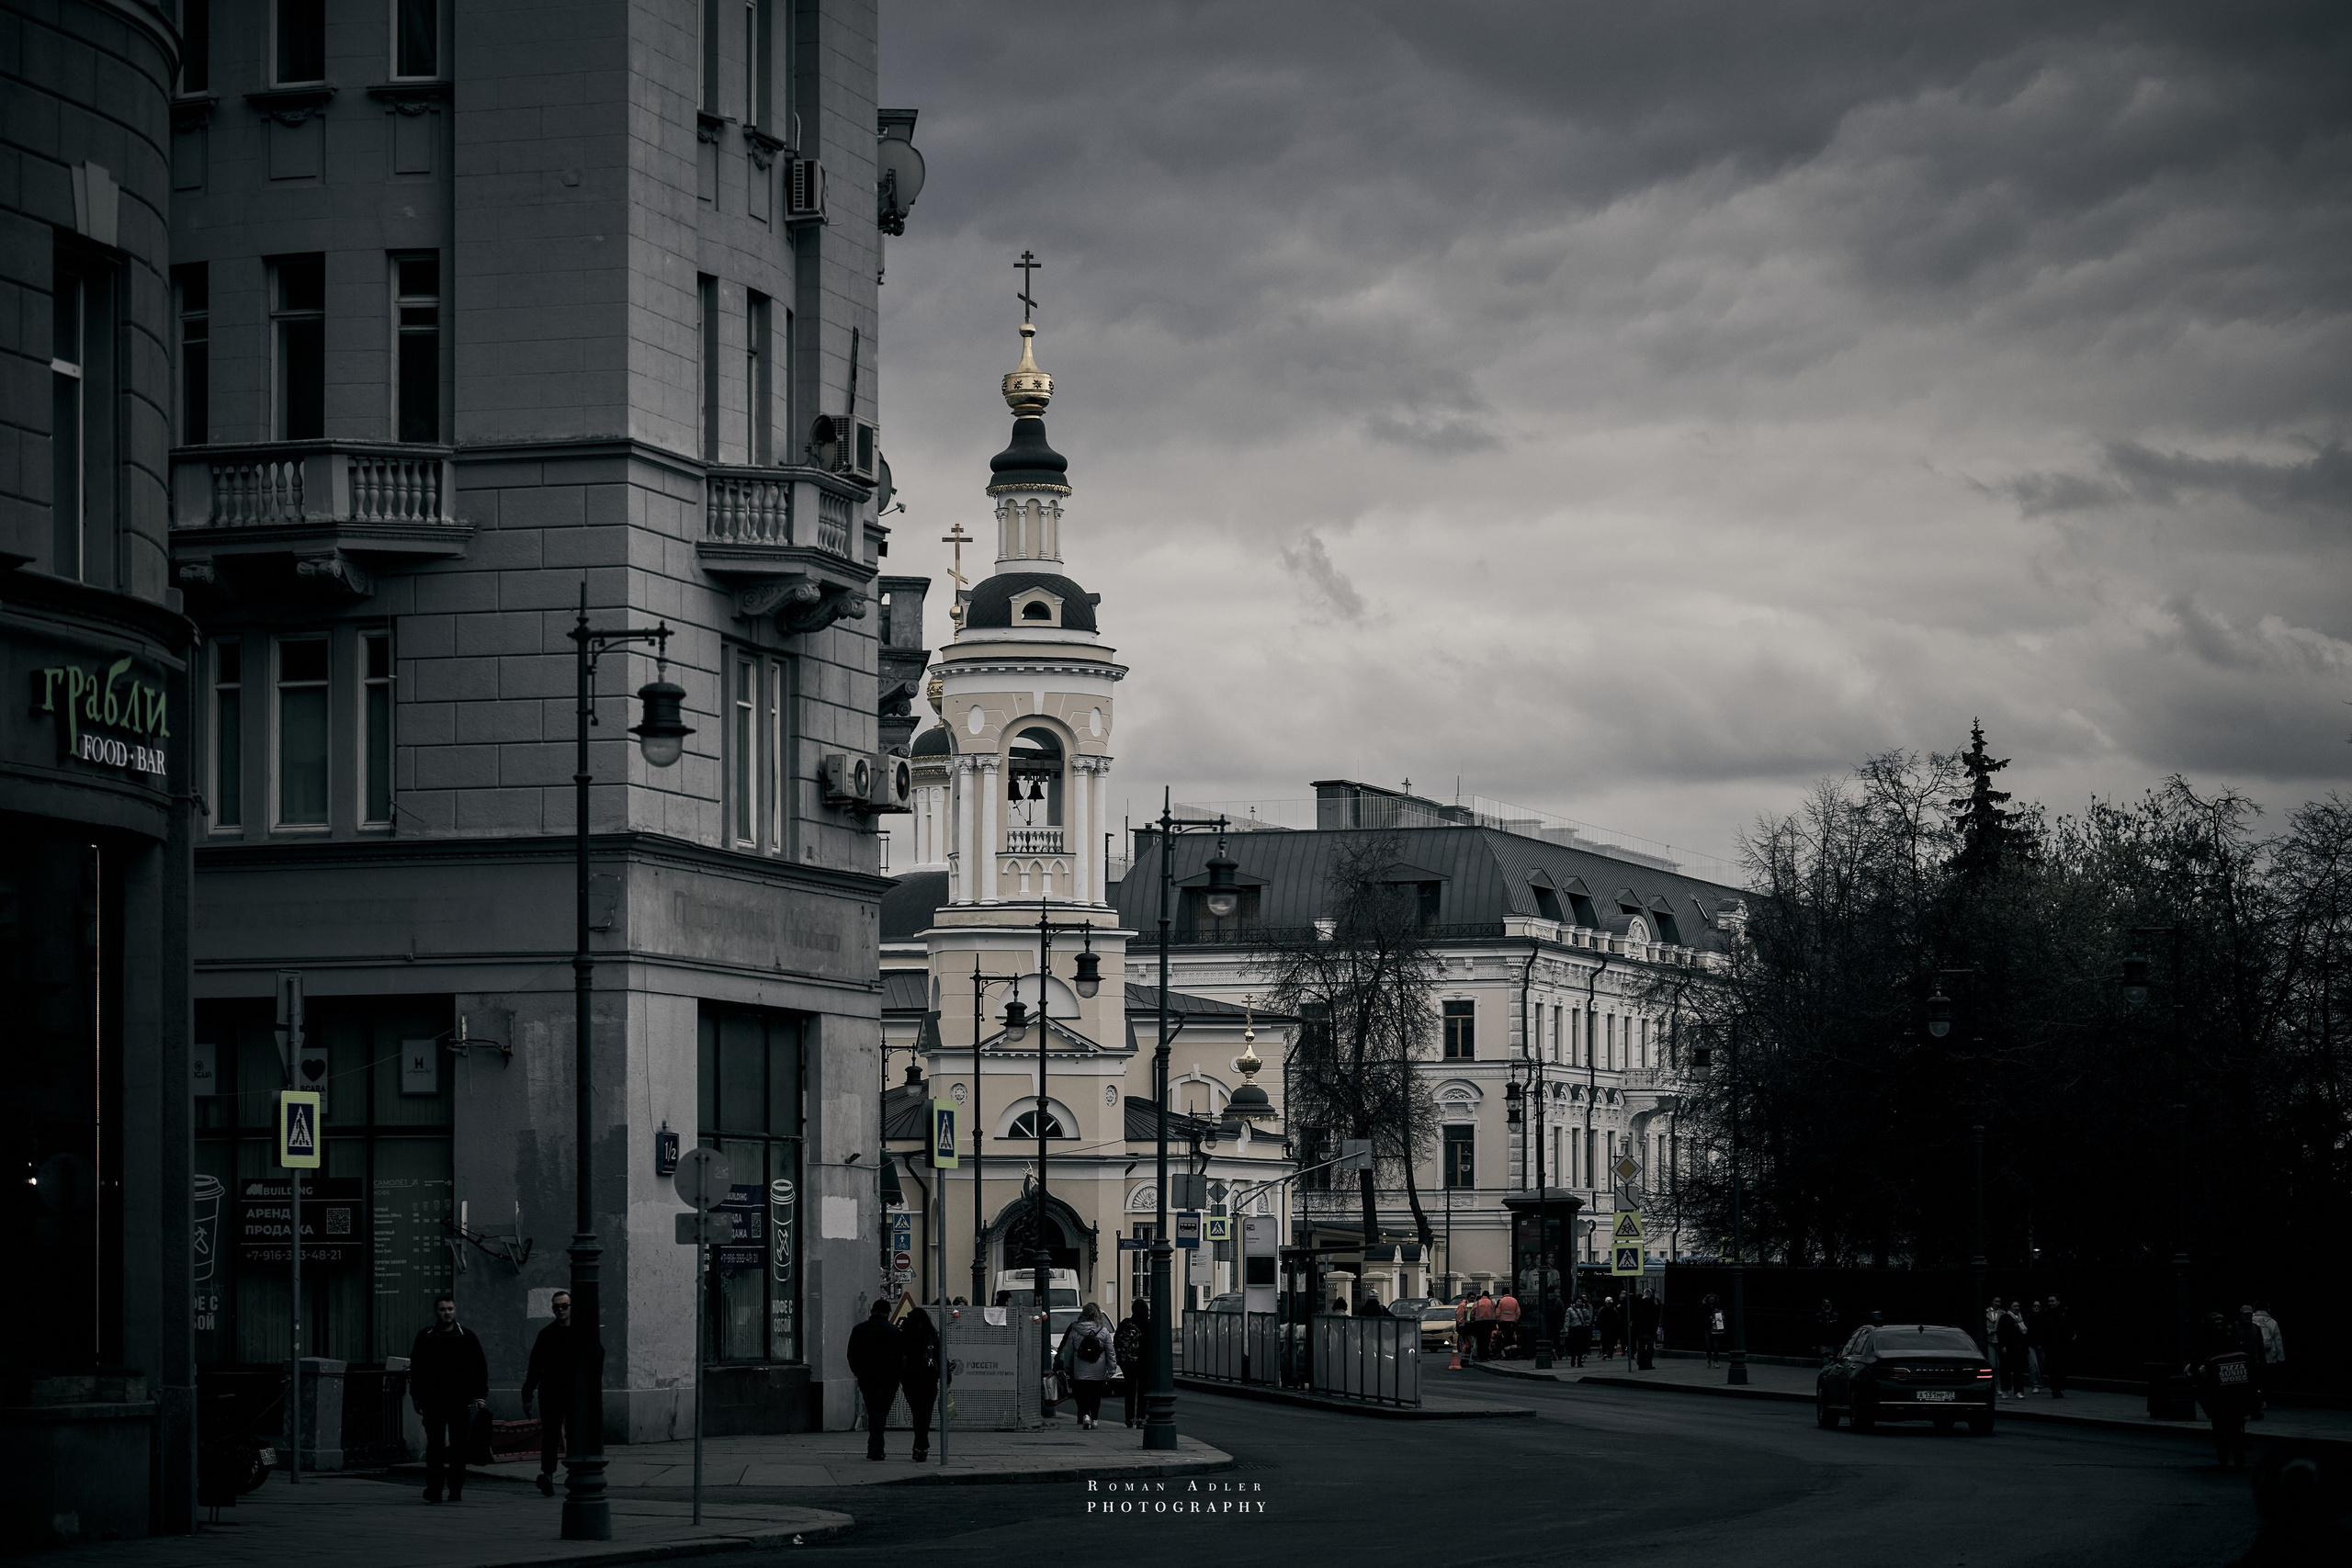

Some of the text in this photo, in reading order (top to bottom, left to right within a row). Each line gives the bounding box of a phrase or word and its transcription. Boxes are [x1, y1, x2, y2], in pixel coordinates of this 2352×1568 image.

[664, 1140, 677, 1163] 1/2
[263, 1186, 314, 1195] BUILDNG
[245, 1208, 291, 1220] АРЕНД
[244, 1249, 343, 1261] +7-916-33-48-21
[209, 1295, 219, 1311] С
[772, 1299, 787, 1314] КОФЕ
[966, 1361, 999, 1370] РОССЕТИ
[2220, 1363, 2245, 1372] PIZZA
[2219, 1369, 2248, 1378] SUSHI
